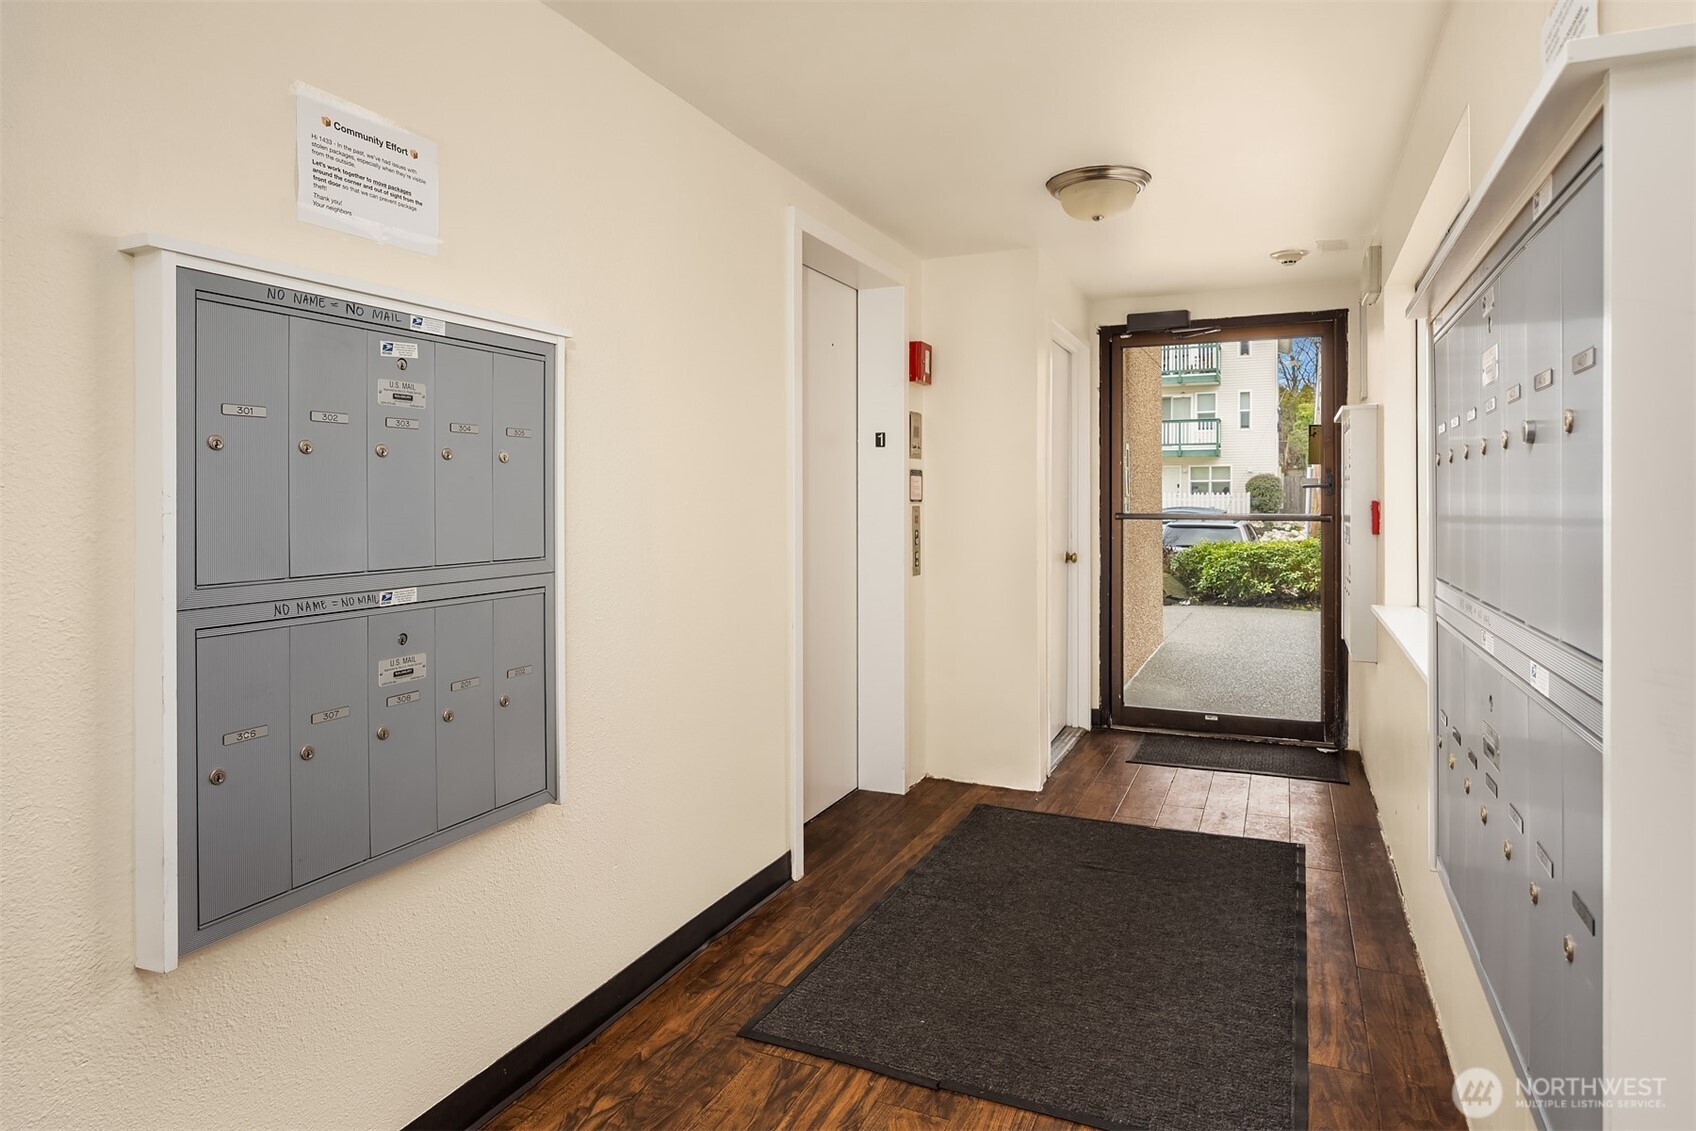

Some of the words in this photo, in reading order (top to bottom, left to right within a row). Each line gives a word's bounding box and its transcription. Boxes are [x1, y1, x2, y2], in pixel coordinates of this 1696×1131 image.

[333, 121, 384, 148] Community
[385, 140, 409, 156] Effort
[311, 133, 318, 141] Hi
[319, 136, 333, 146] 1433
[343, 144, 352, 152] the
[366, 154, 381, 162] we've
[381, 158, 391, 166] had
[391, 162, 407, 171] issues
[407, 167, 418, 175] with
[311, 148, 325, 158] from
[325, 153, 335, 161] the
[311, 141, 329, 152] stolen
[356, 157, 381, 170] especially
[382, 165, 395, 174] when
[395, 169, 412, 180] they're
[412, 176, 427, 185] visible
[312, 158, 326, 168] Let's
[326, 164, 342, 173] work
[342, 168, 366, 181] together
[372, 179, 387, 189] move
[387, 184, 412, 197] packages
[312, 168, 333, 178] around
[333, 173, 343, 182] the
[343, 177, 362, 187] corner
[362, 183, 373, 191] and
[389, 191, 403, 200] sight
[402, 195, 415, 204] from
[414, 199, 423, 207] the
[312, 174, 327, 184] front
[327, 179, 342, 188] door
[349, 186, 360, 194] that
[379, 196, 398, 206] prevent
[397, 201, 418, 212] package
[313, 191, 331, 203] Thank
[312, 199, 326, 208] Your
[325, 204, 353, 216] neighbors
[267, 287, 285, 300] NO
[293, 293, 326, 308] NAME
[345, 302, 365, 317] NO
[371, 309, 403, 323] MAIL
[401, 382, 417, 391] MAIL
[236, 406, 254, 415] 301
[322, 413, 338, 422] 302
[395, 419, 411, 428] 303
[458, 424, 471, 432] 304
[877, 432, 884, 447] 1
[273, 603, 290, 618] NO
[296, 600, 328, 615] NAME
[340, 597, 356, 608] NO
[357, 593, 380, 606] MAIL
[402, 656, 417, 665] MAIL
[396, 694, 412, 704] 308
[322, 710, 340, 721] 307
